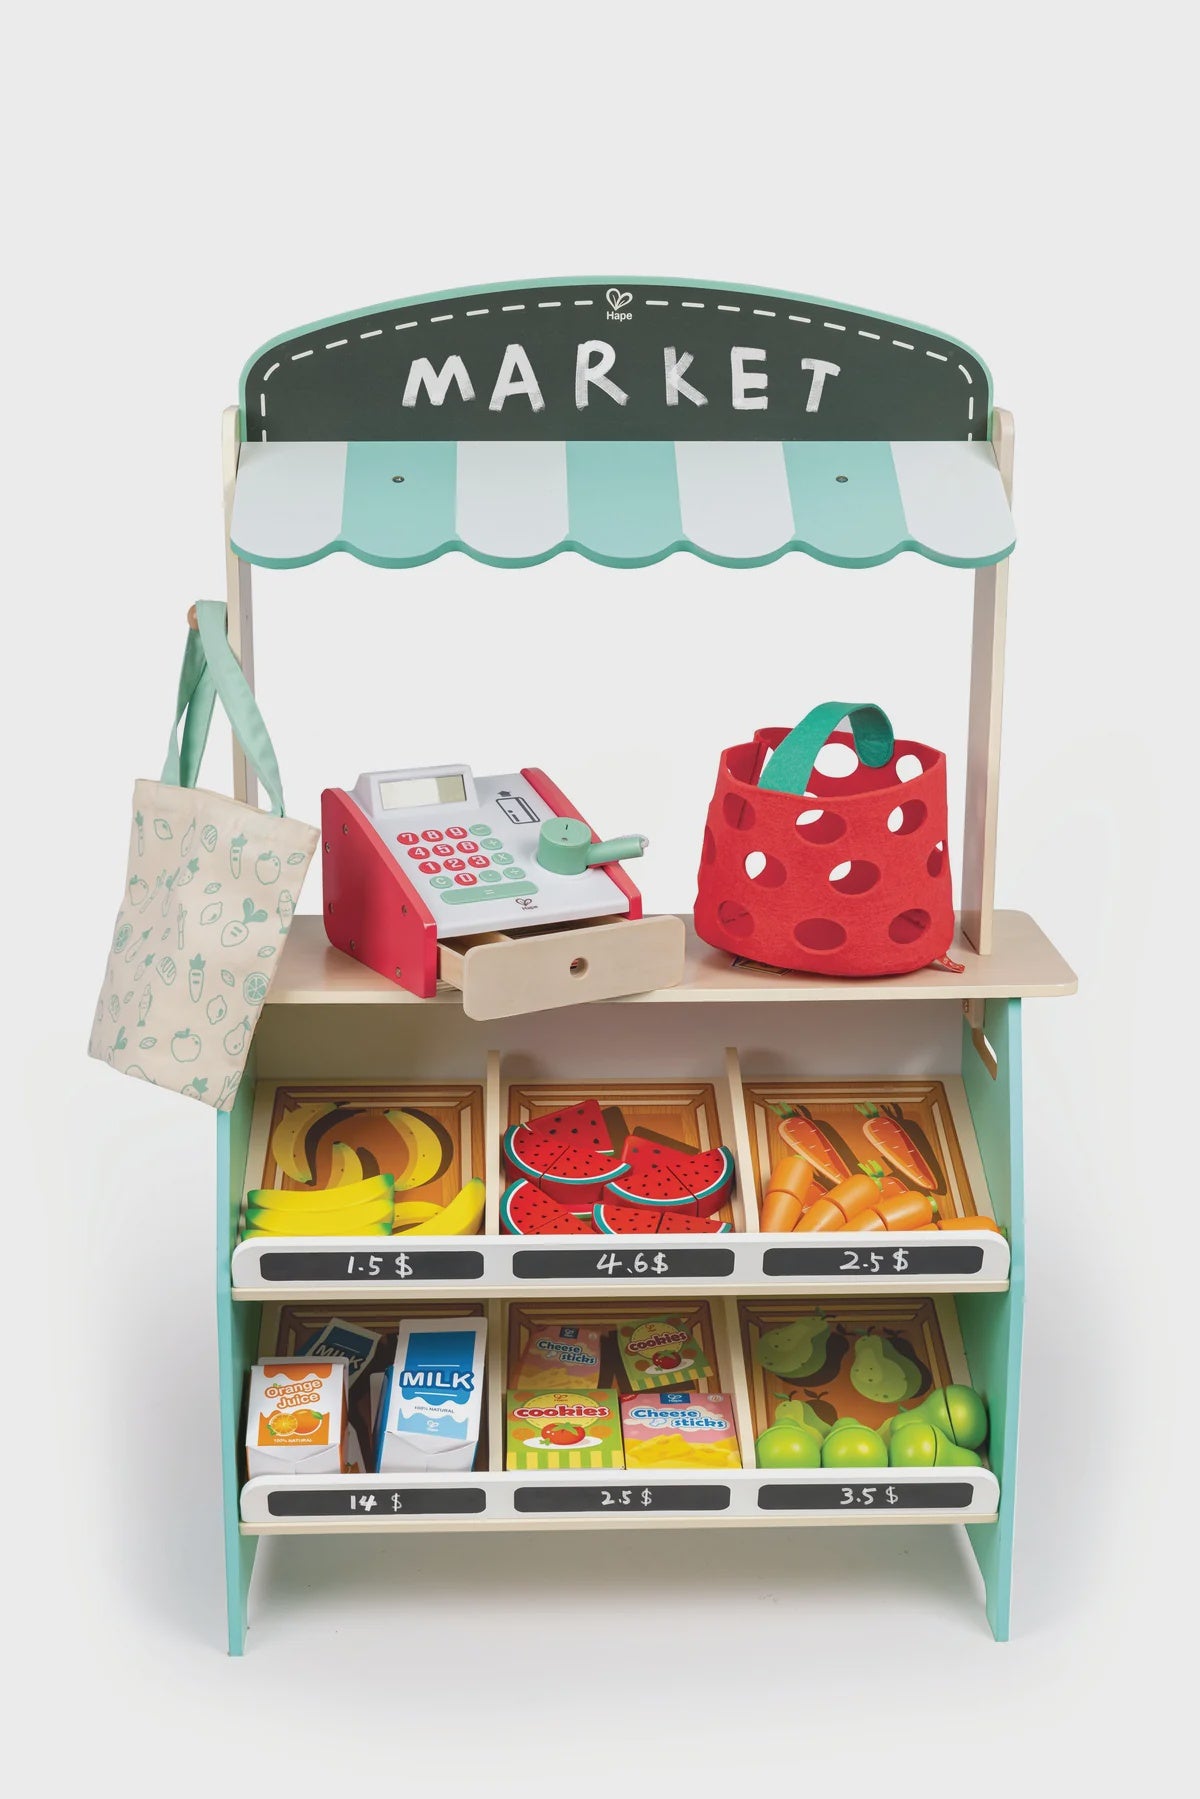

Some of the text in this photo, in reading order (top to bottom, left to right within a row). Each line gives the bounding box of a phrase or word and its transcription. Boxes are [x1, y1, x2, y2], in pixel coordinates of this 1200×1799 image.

[606, 310, 633, 322] Hape
[402, 340, 841, 413] MARKET
[401, 833, 413, 842] 7
[426, 830, 440, 839] 8
[450, 828, 464, 836] 9
[414, 847, 426, 857] 4
[438, 845, 451, 854] 5
[461, 841, 475, 850] 6
[425, 862, 436, 871] 1
[448, 858, 462, 868] 2
[472, 855, 486, 865] 3
[459, 873, 472, 883] 0
[347, 1252, 413, 1278] 1.5 $
[839, 1247, 909, 1273] 2.5 $
[537, 1340, 581, 1354] Cheese
[628, 1331, 688, 1352] cookies
[560, 1352, 596, 1364] sticks
[402, 1371, 473, 1390] MILK
[265, 1380, 323, 1398] Orange
[277, 1393, 320, 1409] Juice
[515, 1404, 609, 1418] cookies
[632, 1408, 698, 1418] Cheese
[673, 1417, 724, 1428] sticks
[350, 1492, 402, 1512] 14 $
[601, 1487, 652, 1506] 2.5 $
[840, 1485, 899, 1505] 3.5 $
